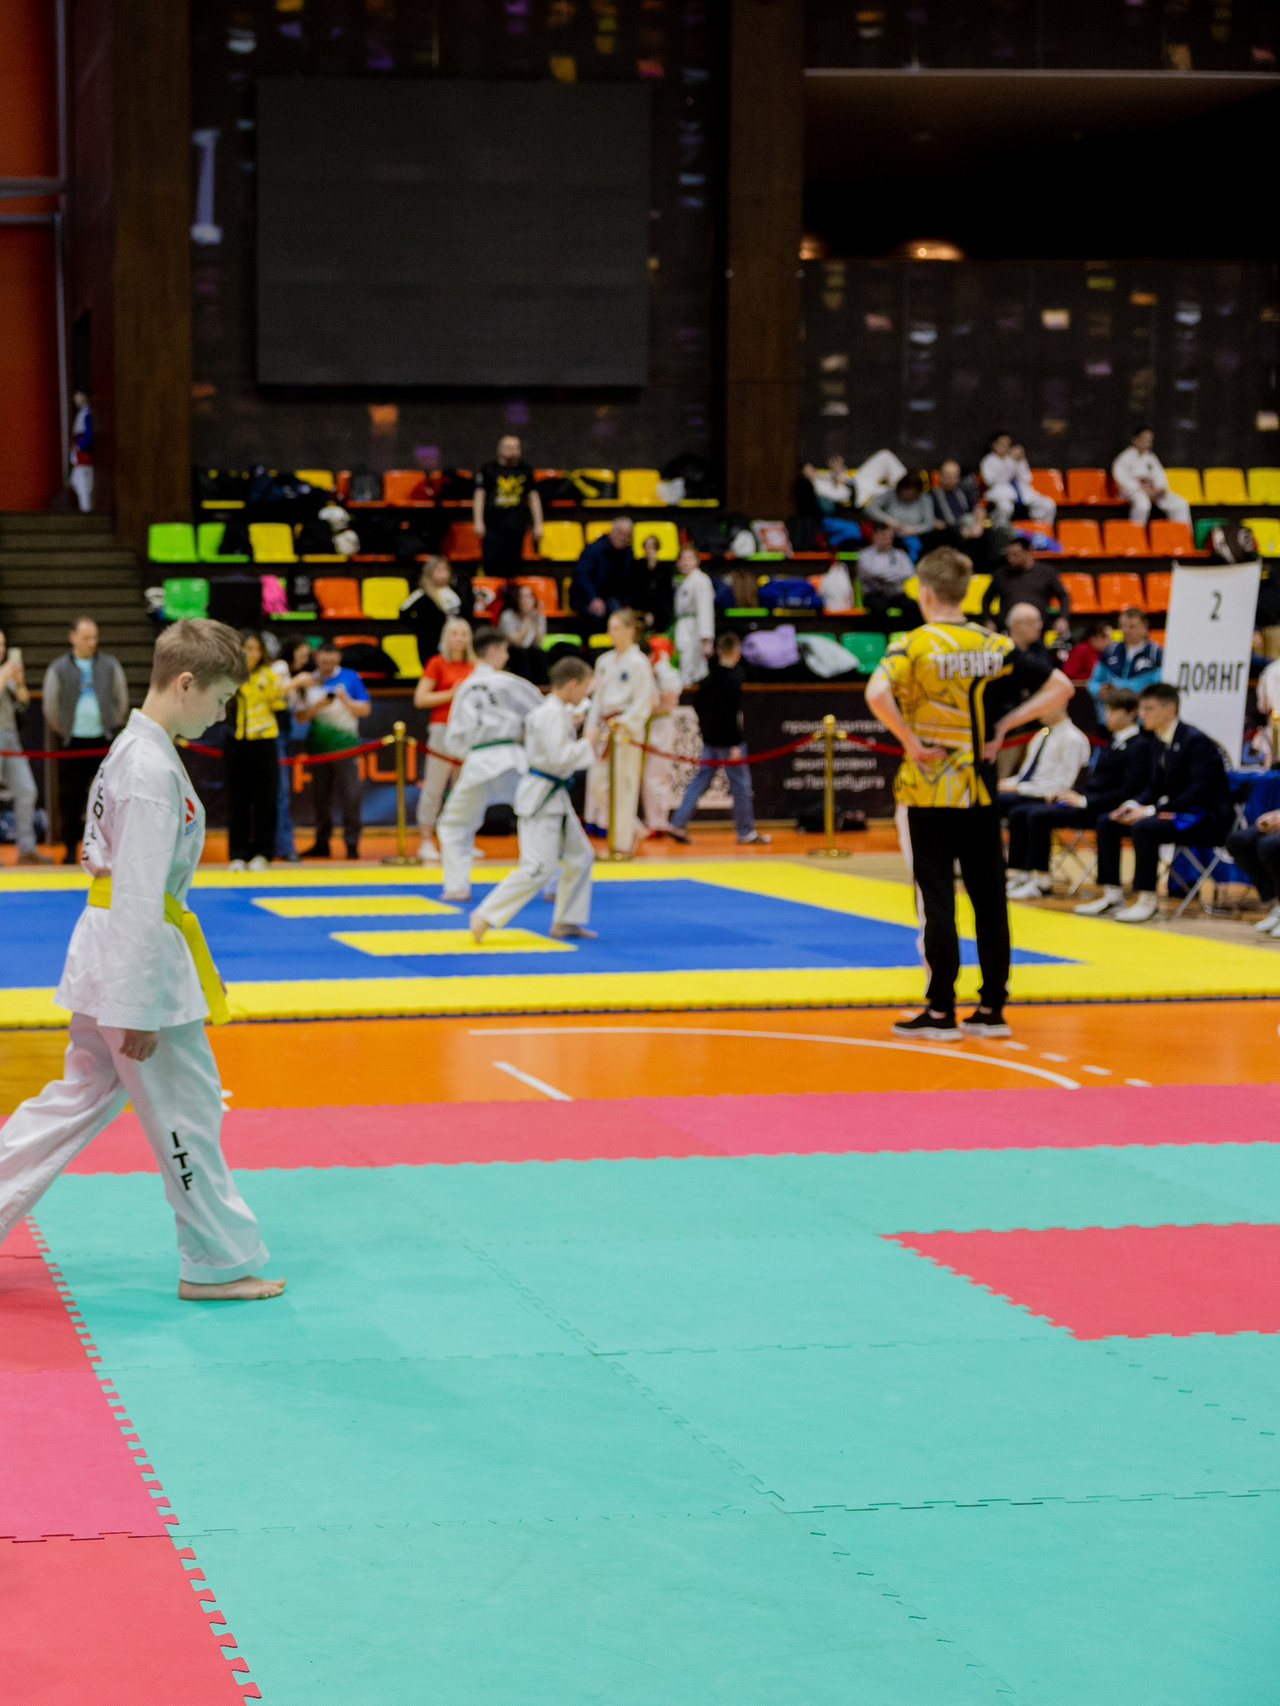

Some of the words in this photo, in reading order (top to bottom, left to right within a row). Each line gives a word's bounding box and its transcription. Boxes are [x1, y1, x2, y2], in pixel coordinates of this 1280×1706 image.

[1210, 590, 1222, 621] 2
[927, 650, 1004, 680] ТРЕНЕР
[1178, 661, 1245, 697] ДОЯНГ
[171, 1131, 194, 1191] ITF
